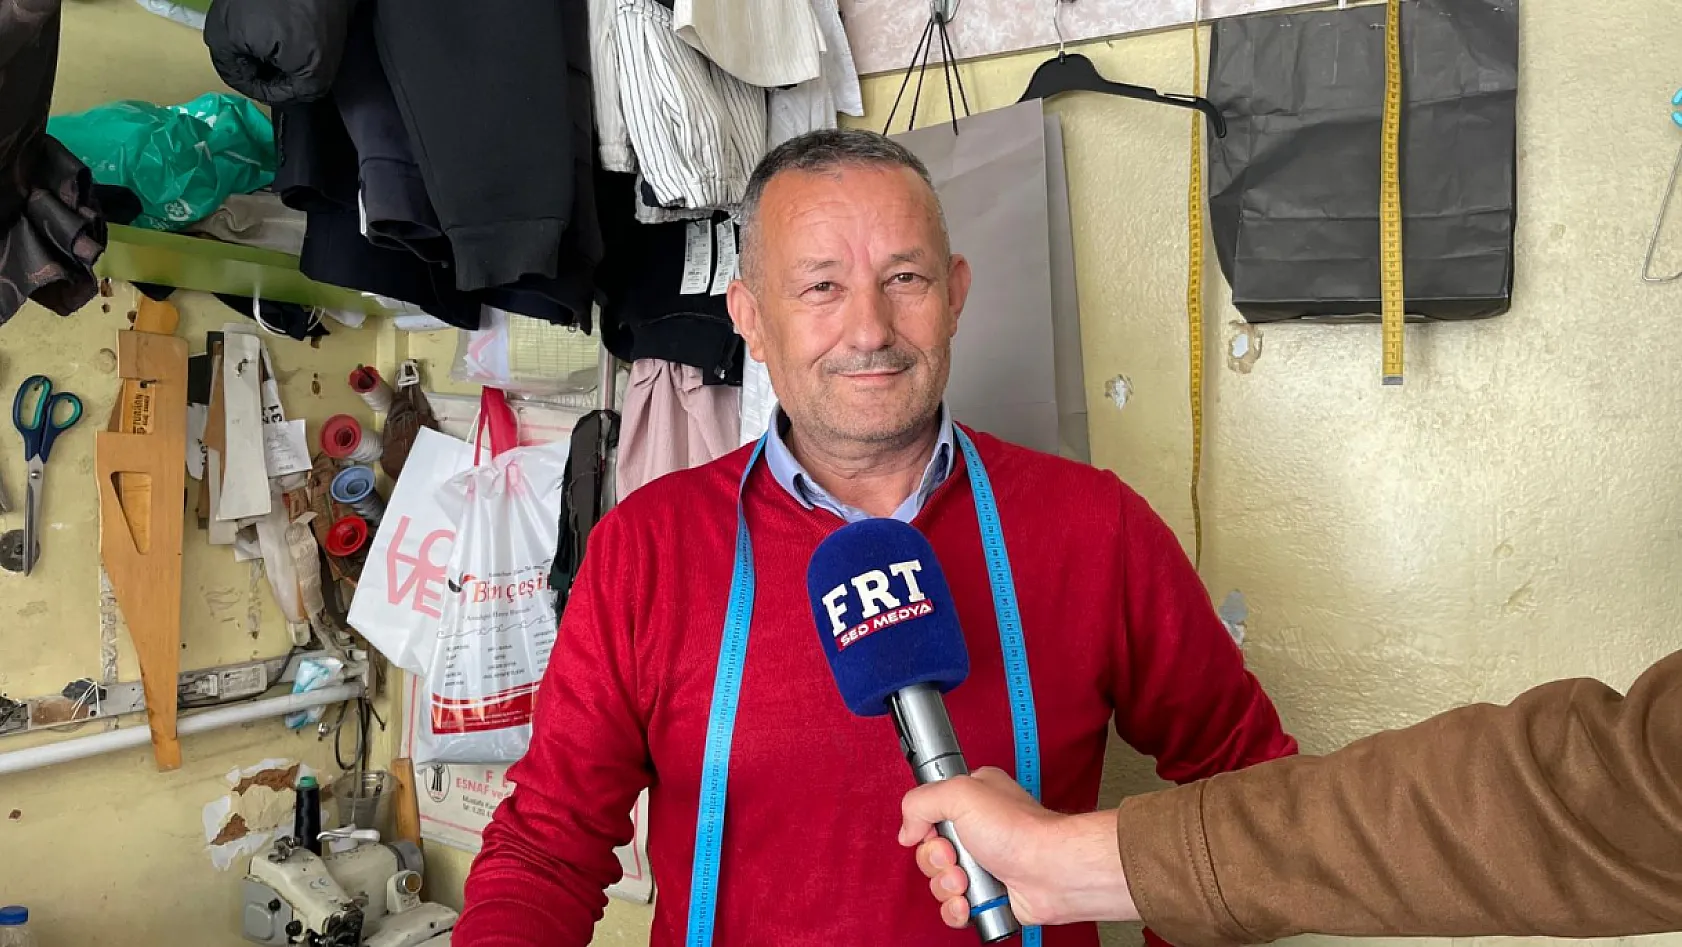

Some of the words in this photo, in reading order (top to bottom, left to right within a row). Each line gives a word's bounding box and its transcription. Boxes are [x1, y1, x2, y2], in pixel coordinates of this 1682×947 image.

[821, 559, 927, 637] FRT
[840, 623, 870, 648] SED
[873, 602, 933, 630] MEDYA
[456, 777, 489, 795] ESNAF
